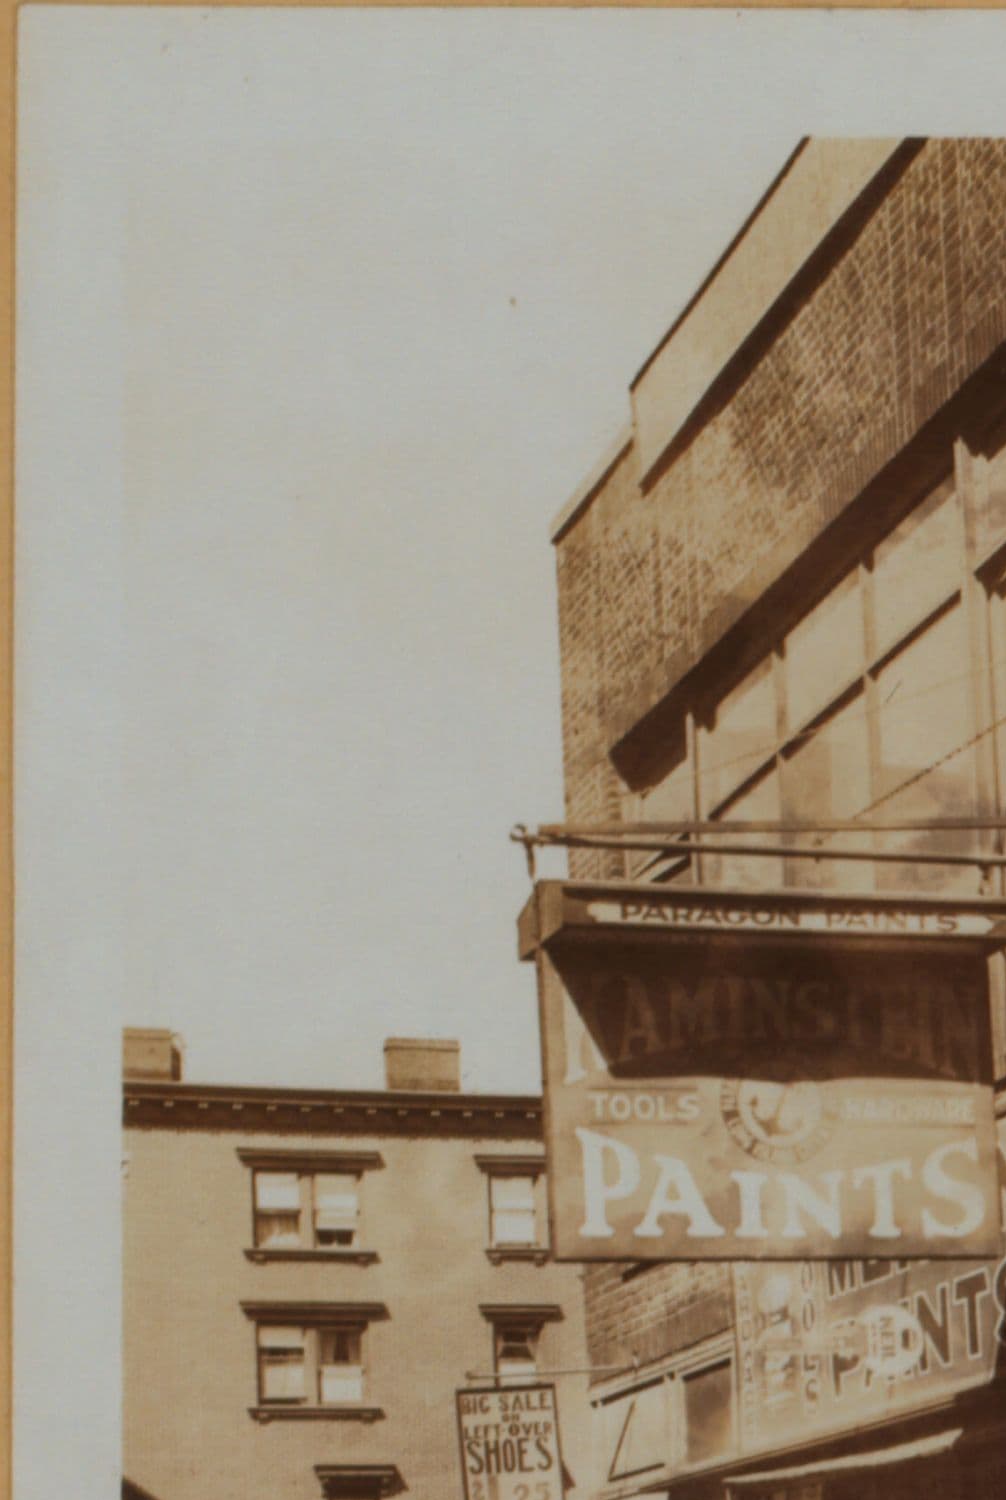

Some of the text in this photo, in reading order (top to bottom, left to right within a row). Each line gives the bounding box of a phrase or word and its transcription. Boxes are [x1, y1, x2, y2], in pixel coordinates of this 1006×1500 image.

[619, 903, 959, 932] PARAGON PAINTS
[591, 1093, 699, 1122] TOOLS
[575, 1127, 985, 1239] PAINTS
[460, 1392, 551, 1414] BIG SALE
[466, 1438, 553, 1475] SHOES
